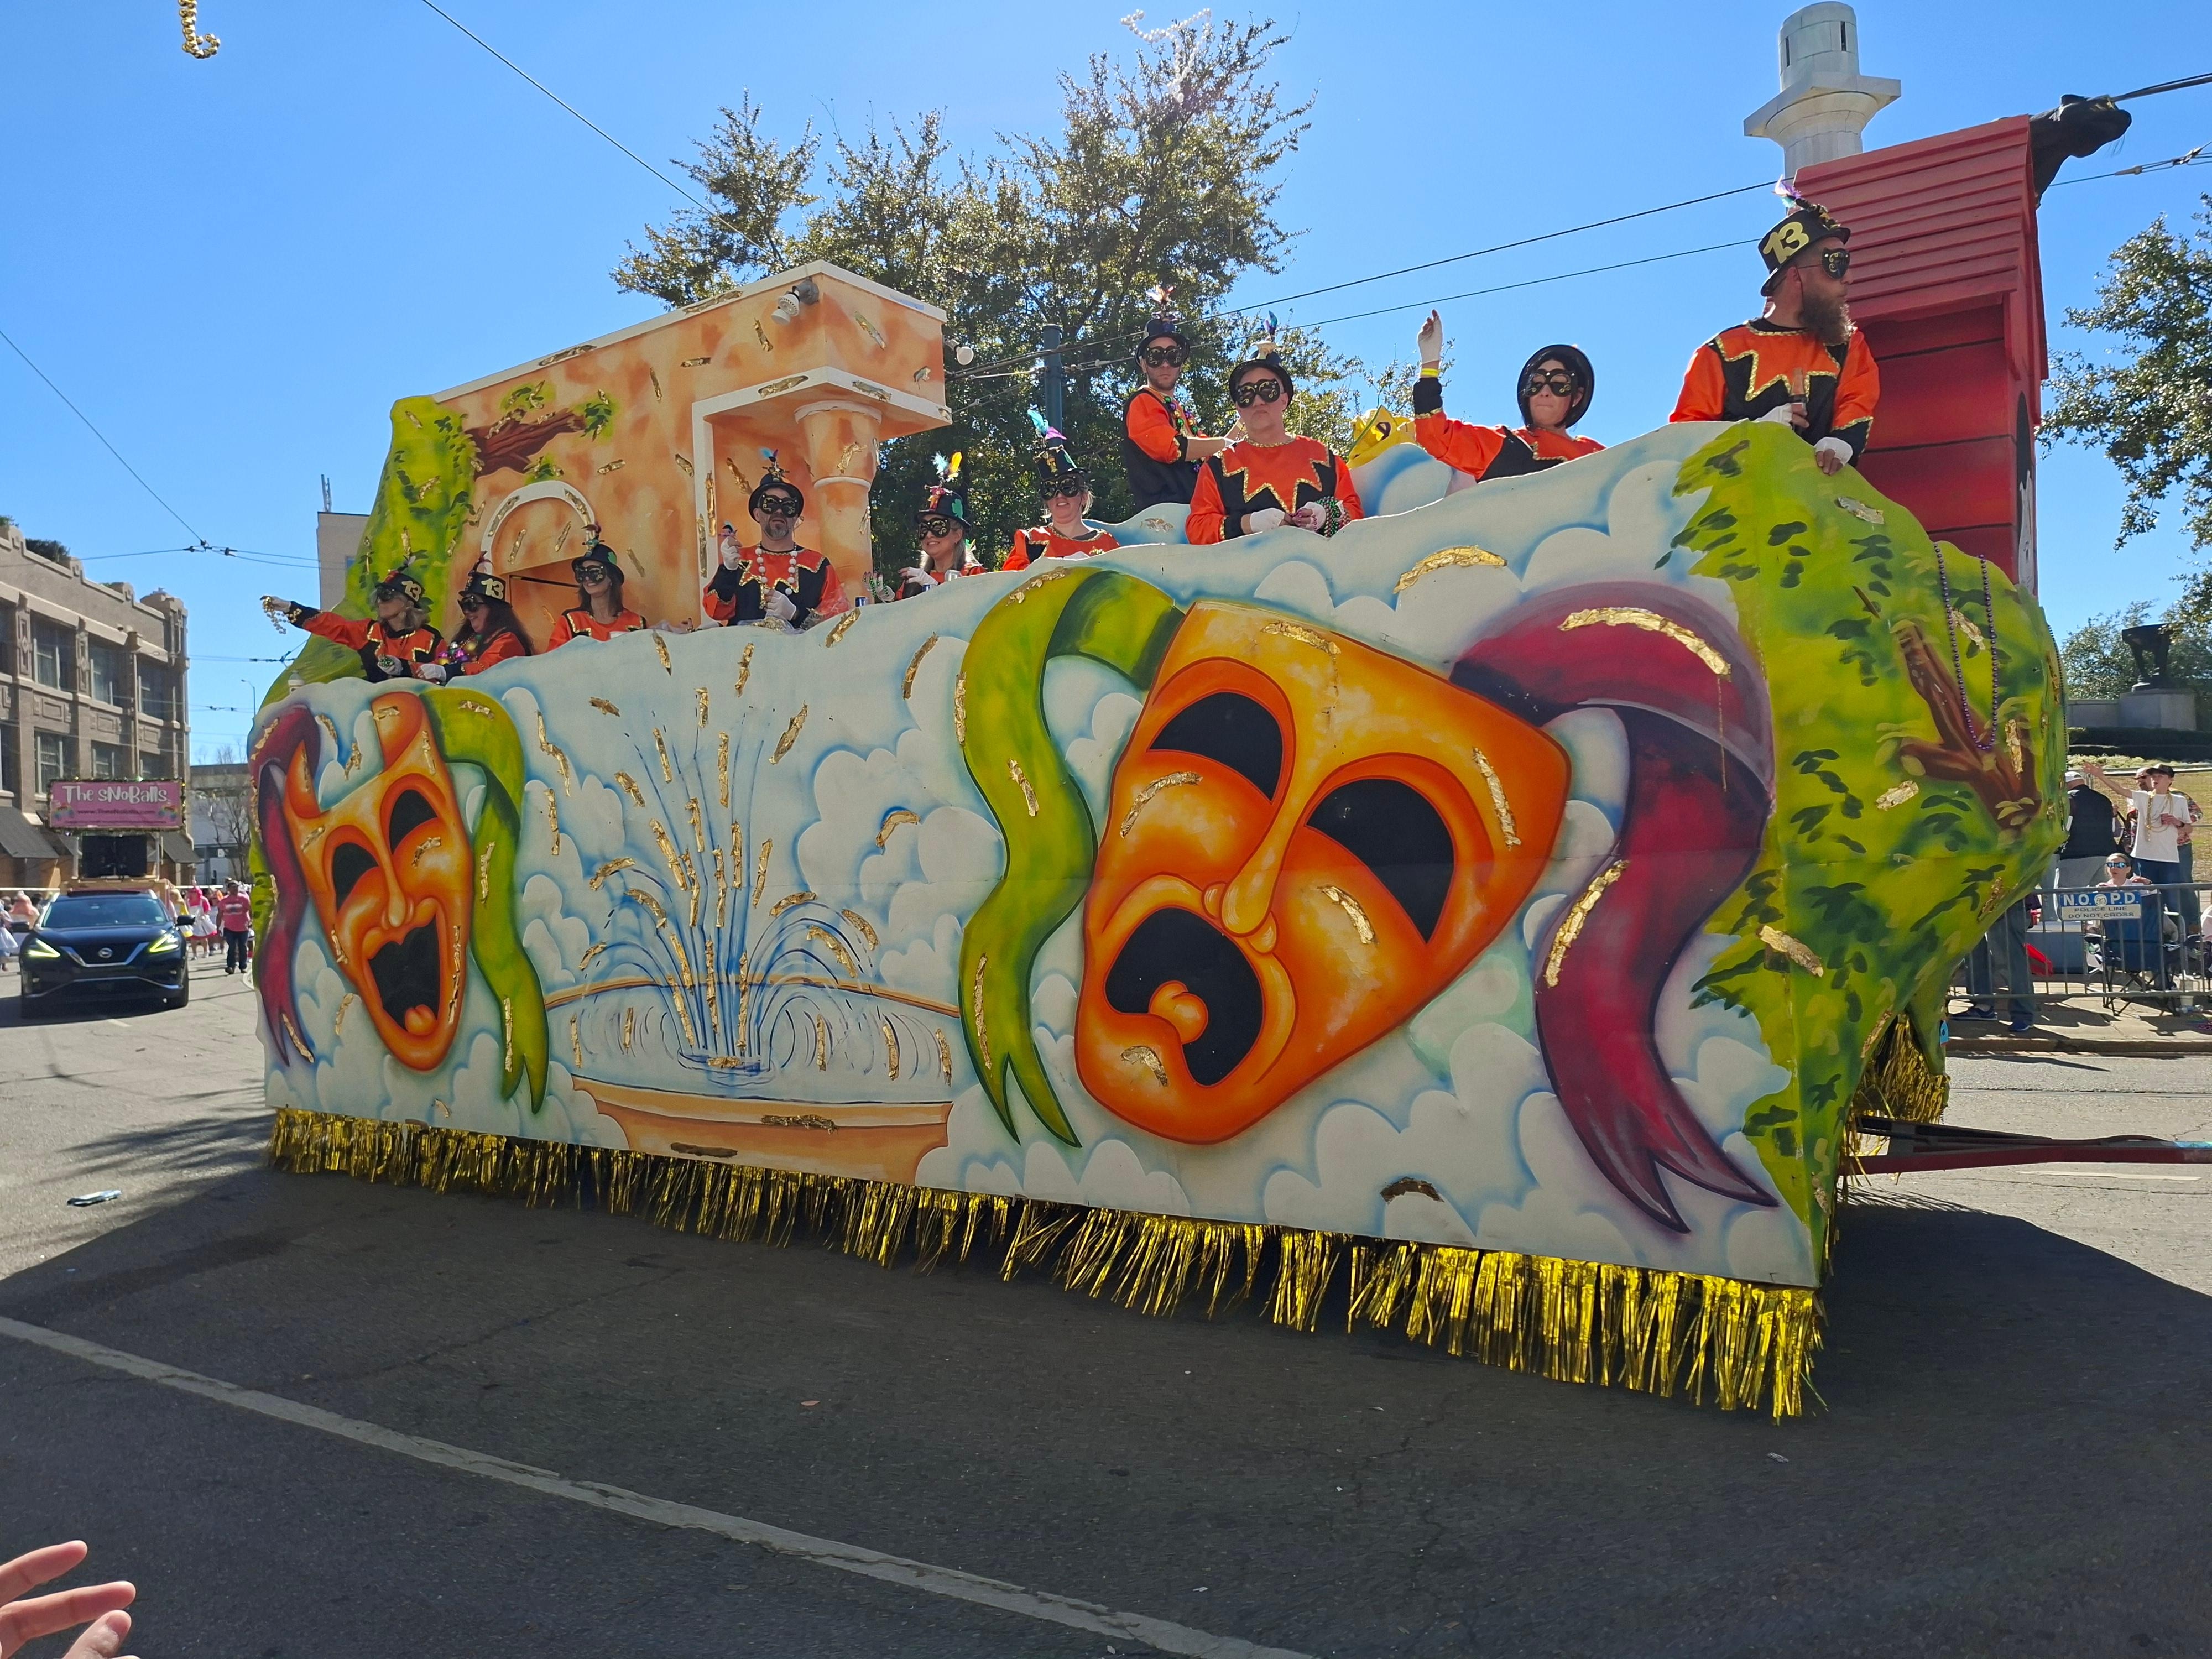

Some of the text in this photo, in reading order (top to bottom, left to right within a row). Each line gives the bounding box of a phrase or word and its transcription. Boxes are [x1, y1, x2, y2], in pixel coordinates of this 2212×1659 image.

[1762, 221, 1809, 264] 13
[401, 580, 422, 602] 13
[481, 578, 504, 600] 13
[62, 785, 168, 804] The sNoBalls
